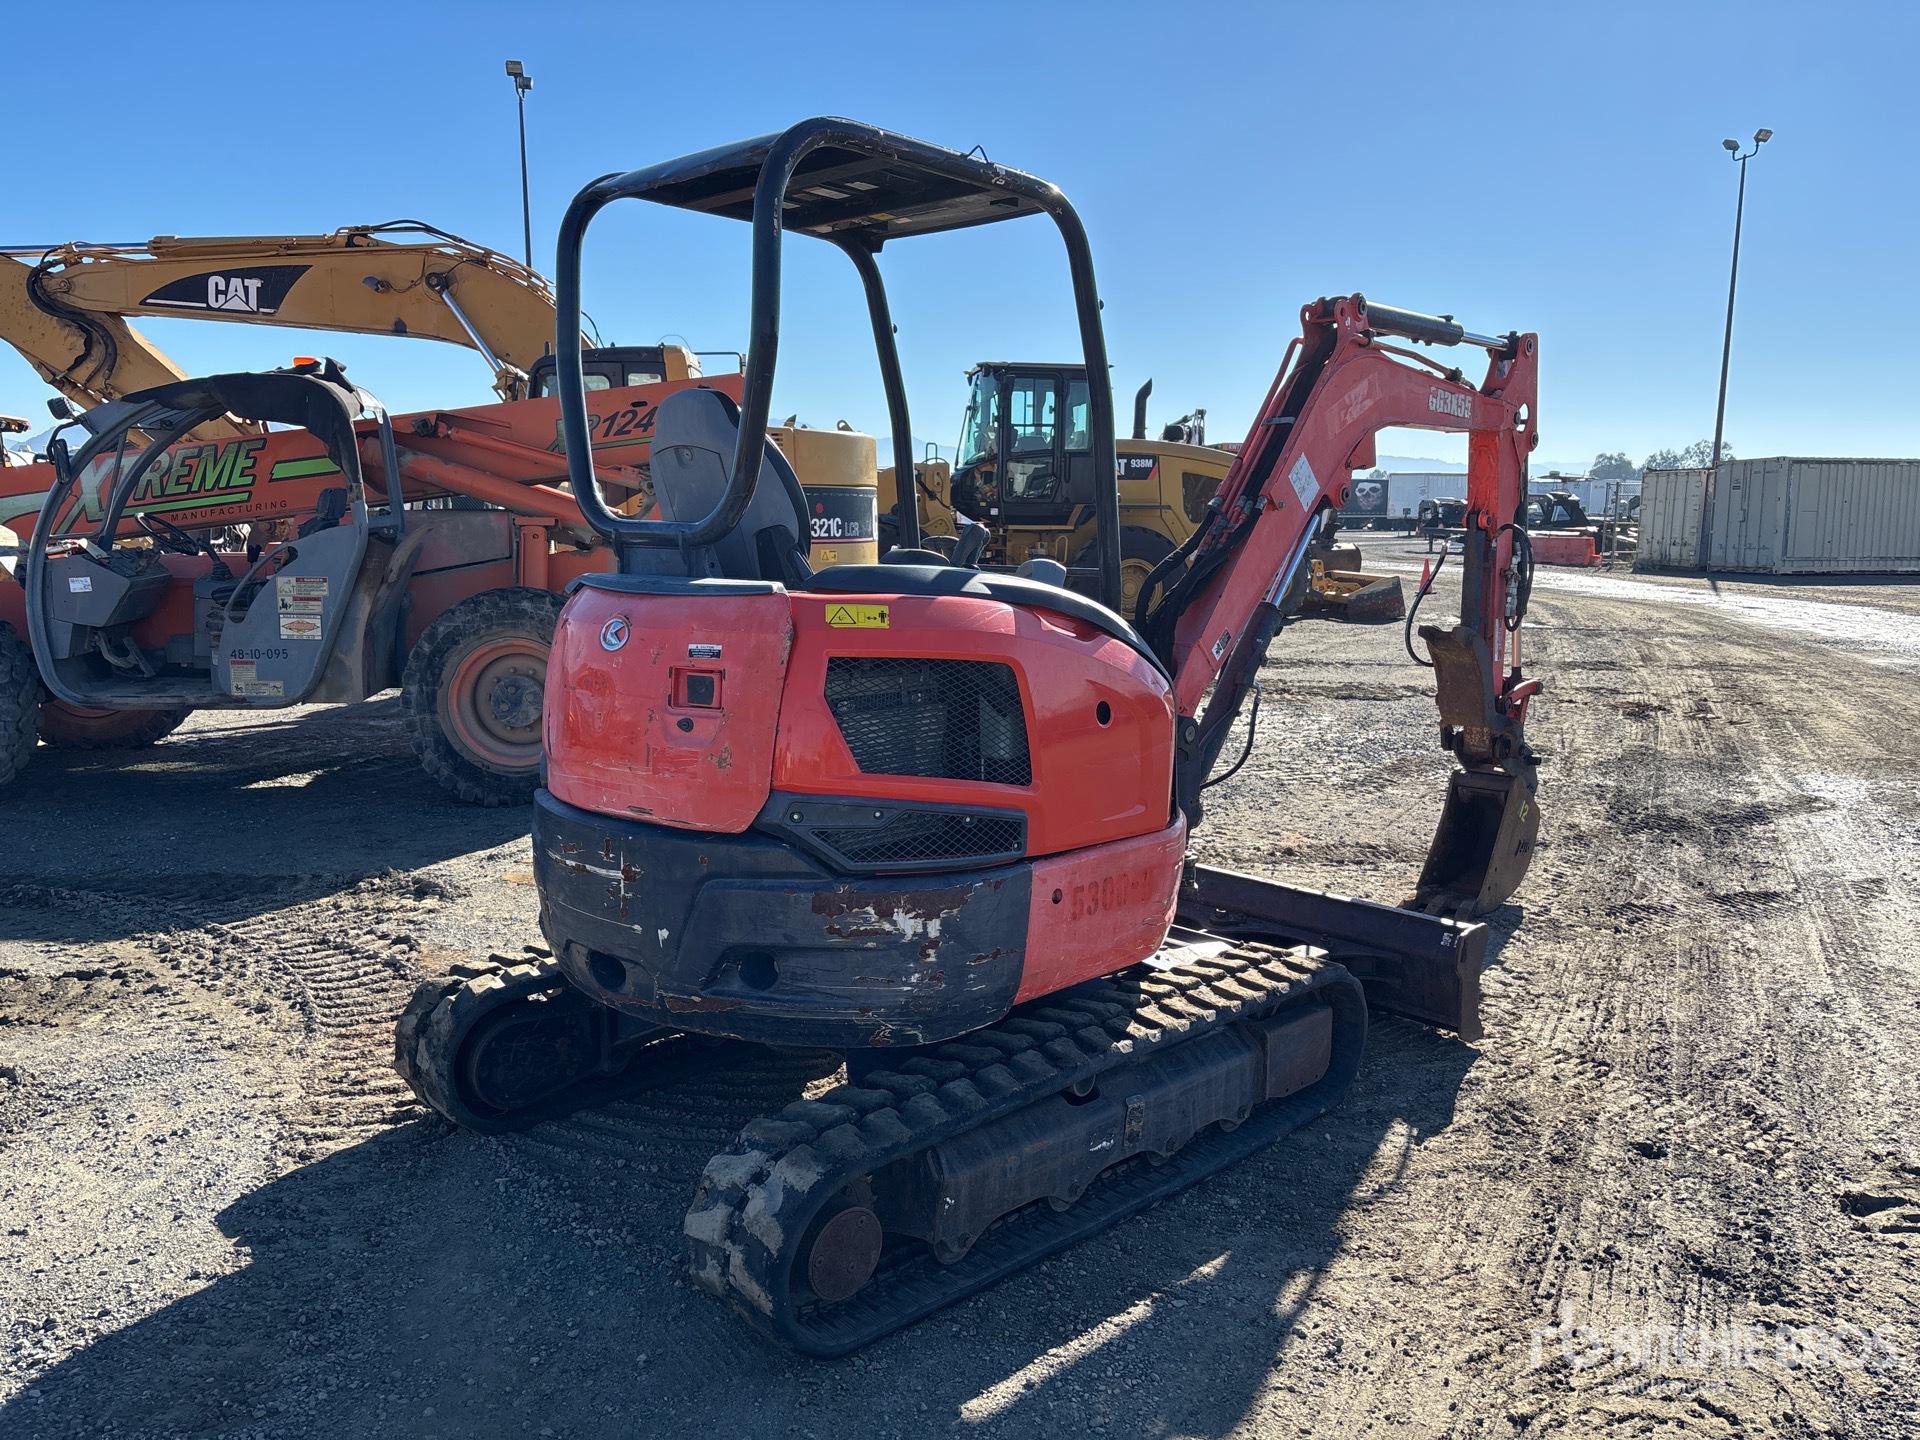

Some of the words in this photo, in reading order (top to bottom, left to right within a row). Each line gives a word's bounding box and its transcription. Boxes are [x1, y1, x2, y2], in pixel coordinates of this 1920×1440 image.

[207, 275, 262, 312] CAT
[1130, 458, 1153, 468] 938M
[170, 499, 289, 522] MANUFACTURING
[810, 517, 842, 538] 321C
[230, 648, 289, 660] 48-10-095
